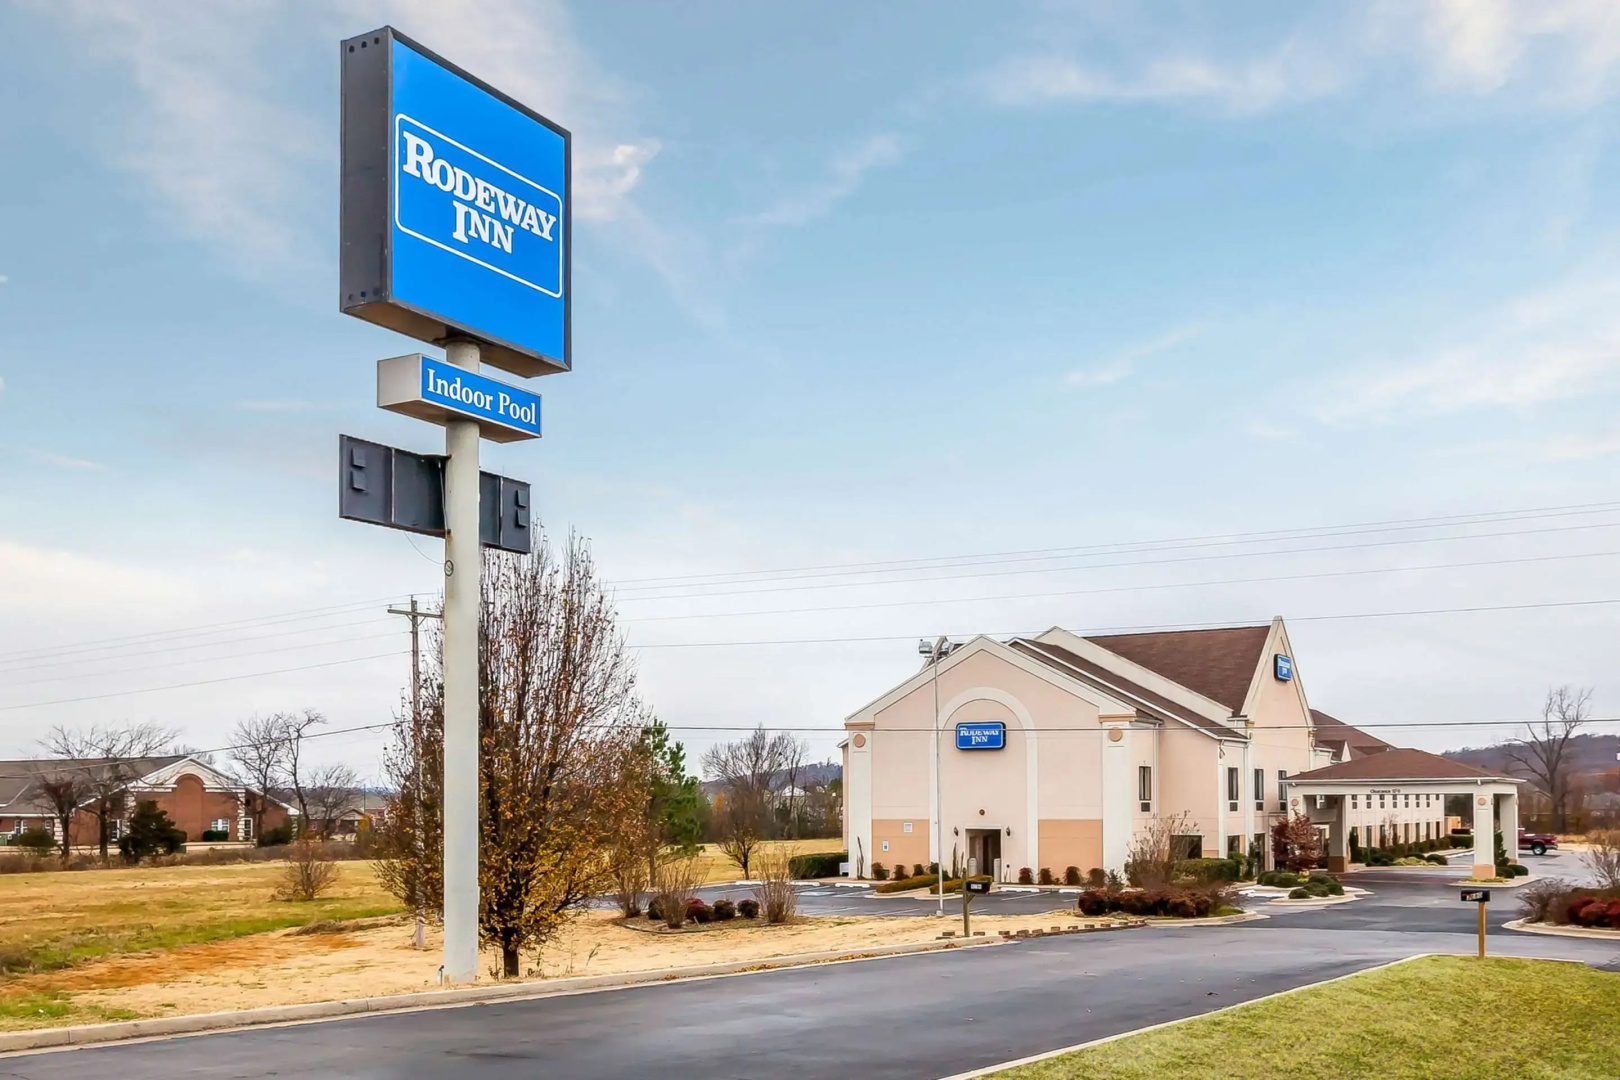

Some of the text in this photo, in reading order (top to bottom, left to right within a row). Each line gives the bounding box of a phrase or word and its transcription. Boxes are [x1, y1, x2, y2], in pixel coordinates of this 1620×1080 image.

[402, 130, 557, 242] RODEWAY
[452, 200, 514, 254] INN
[427, 368, 537, 425] Indoor Pool
[971, 736, 988, 745] INN
